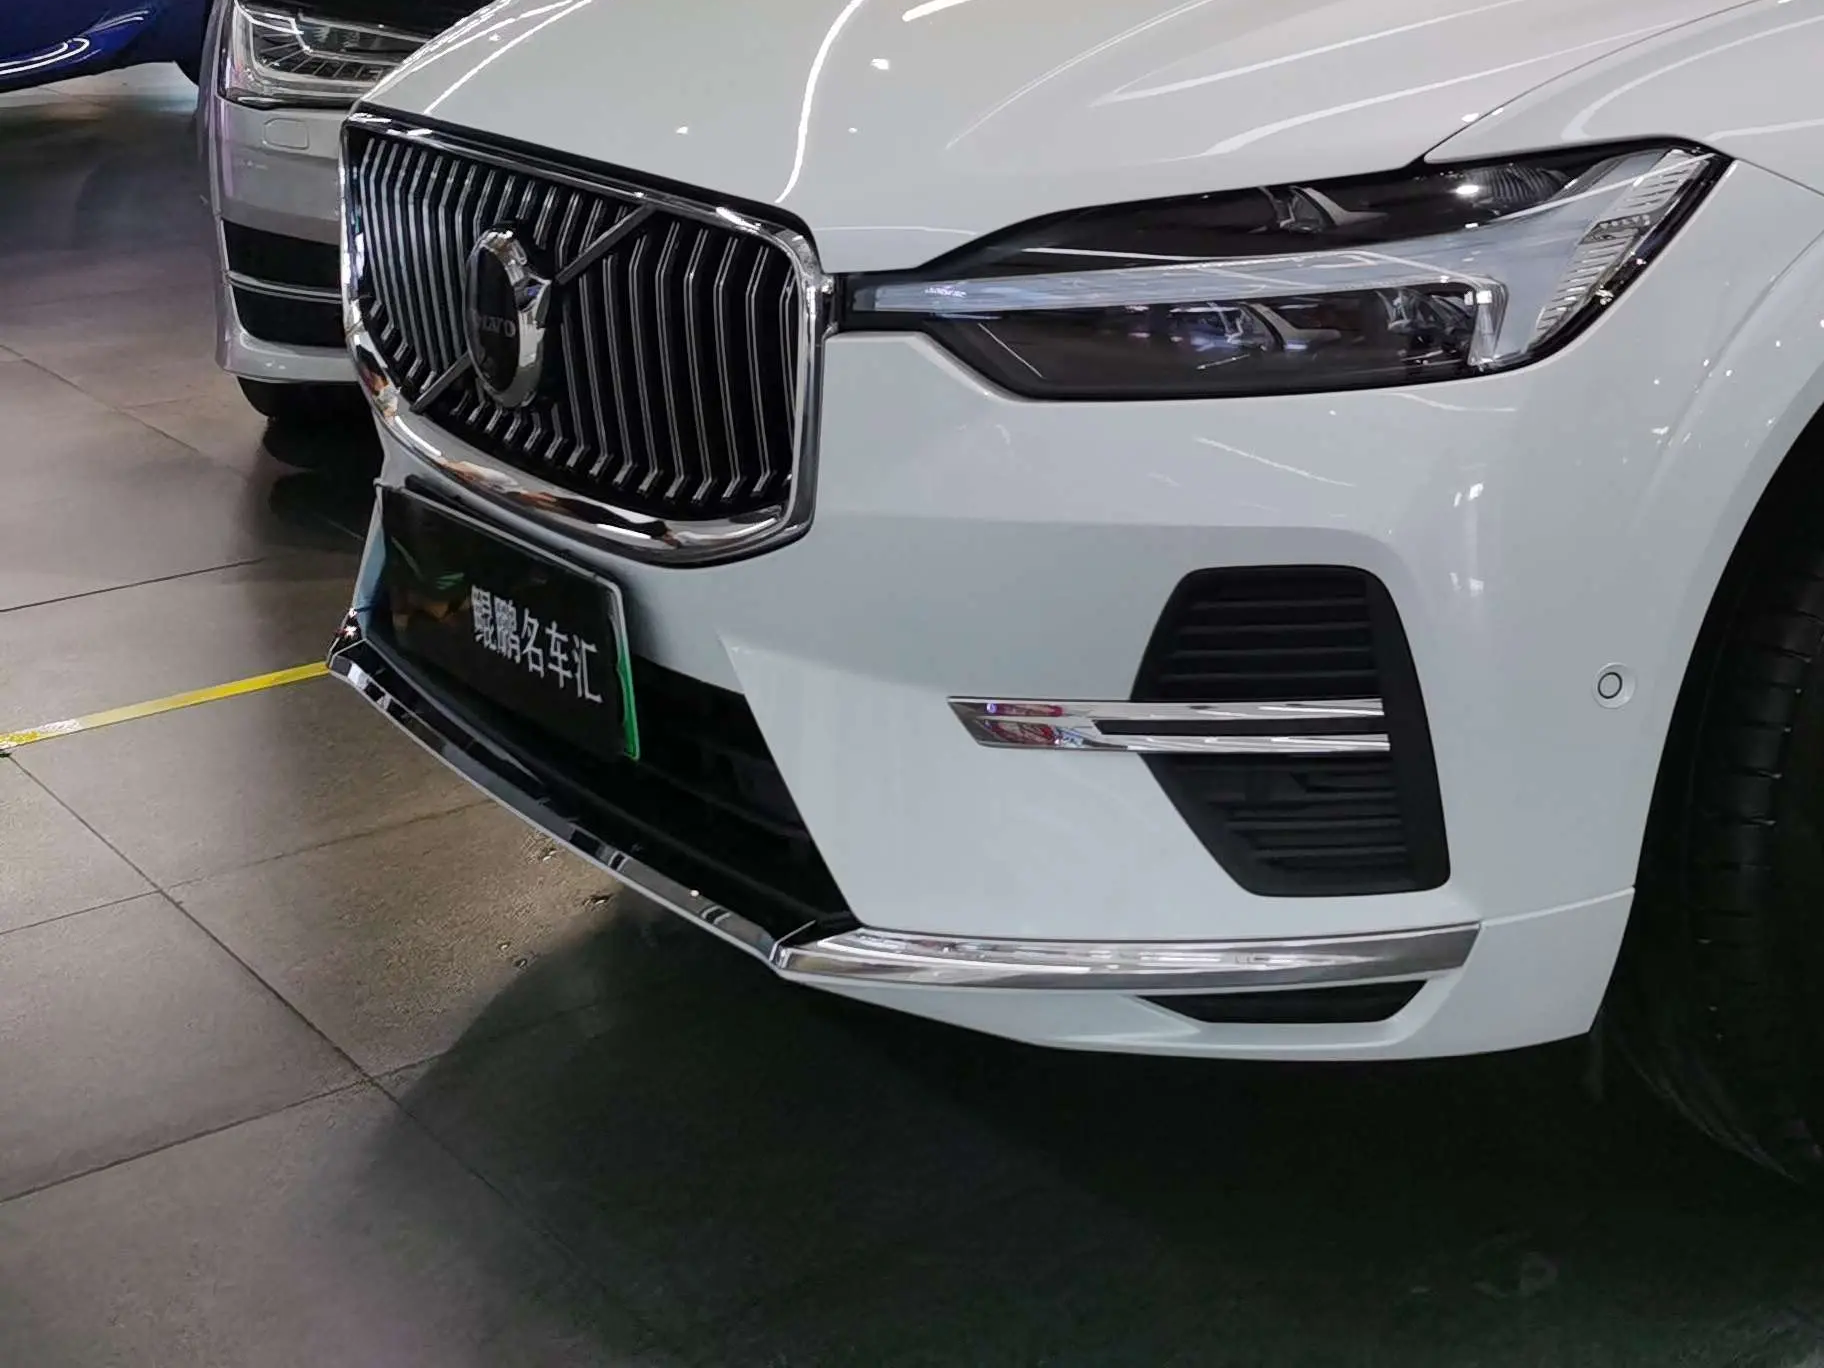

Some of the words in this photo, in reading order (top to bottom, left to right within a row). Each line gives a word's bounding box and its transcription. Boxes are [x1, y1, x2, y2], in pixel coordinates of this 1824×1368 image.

[471, 584, 602, 704] 鲲鹏名车汇
